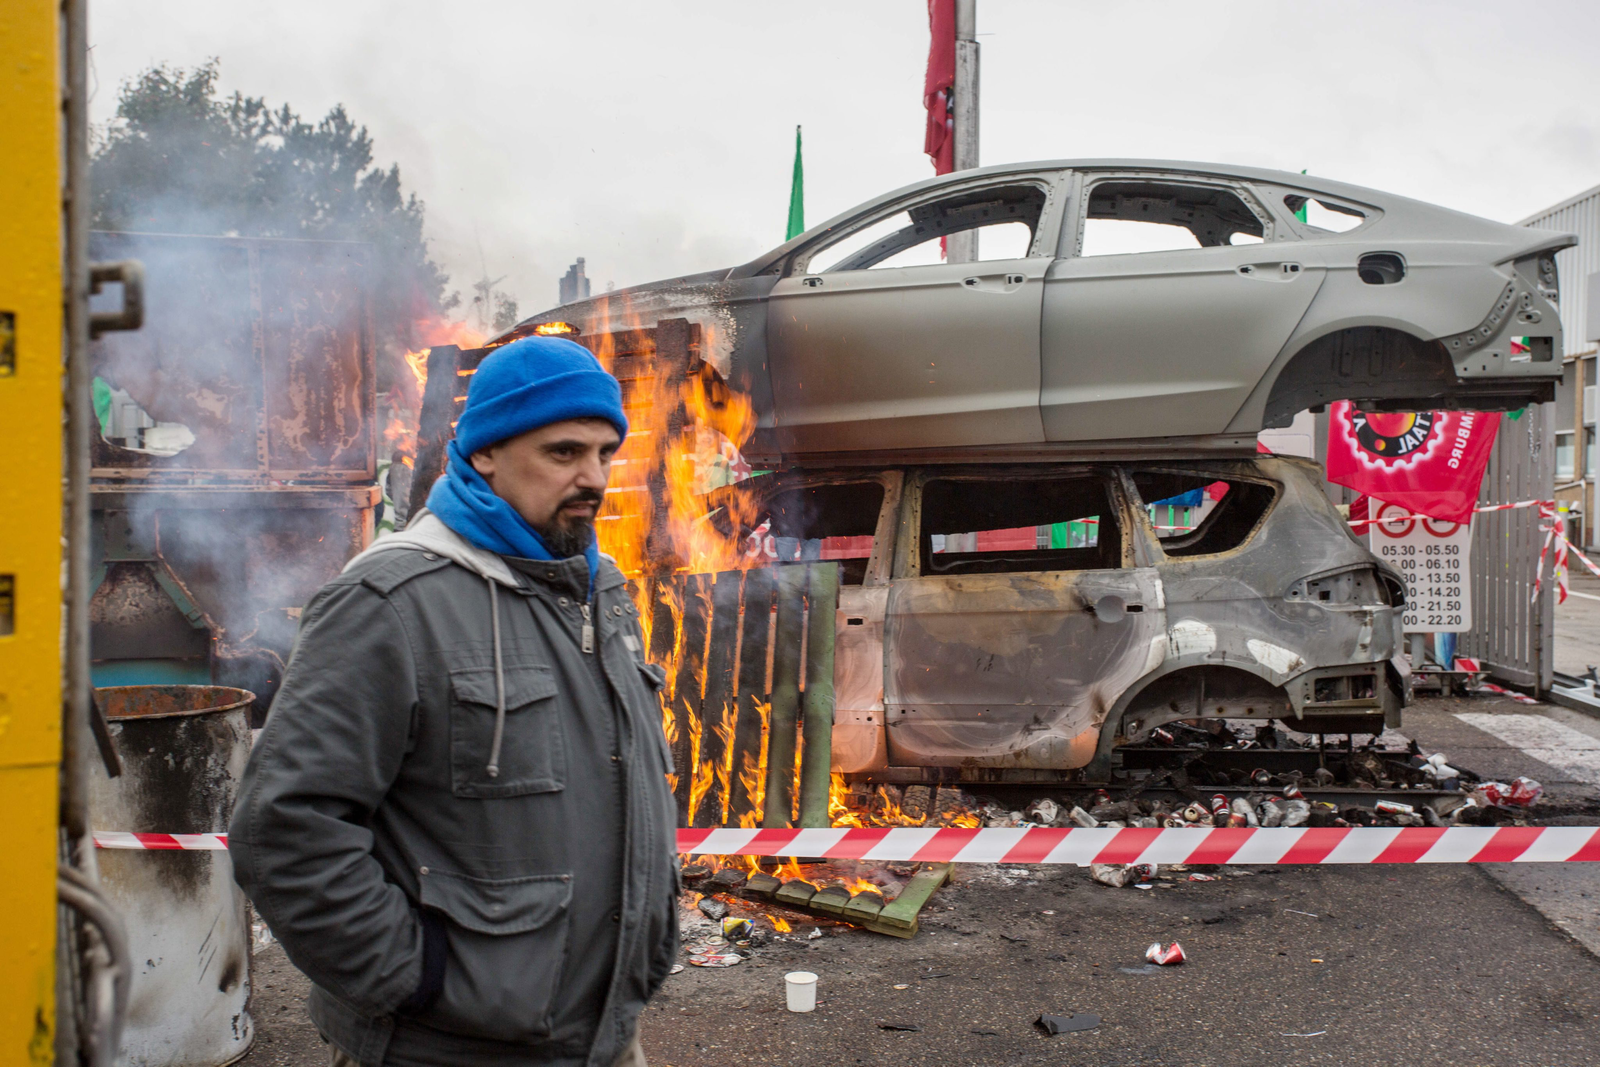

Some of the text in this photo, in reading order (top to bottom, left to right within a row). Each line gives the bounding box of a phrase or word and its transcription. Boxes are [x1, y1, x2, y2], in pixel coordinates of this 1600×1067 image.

[1382, 545, 1416, 556] 05.30
[1425, 545, 1460, 555] 05.50
[1426, 559, 1460, 570] 06.10
[1427, 573, 1460, 584] 13.50
[1428, 587, 1461, 598] 14.20
[1427, 601, 1462, 612] 21.50
[1428, 615, 1462, 626] 22.20
